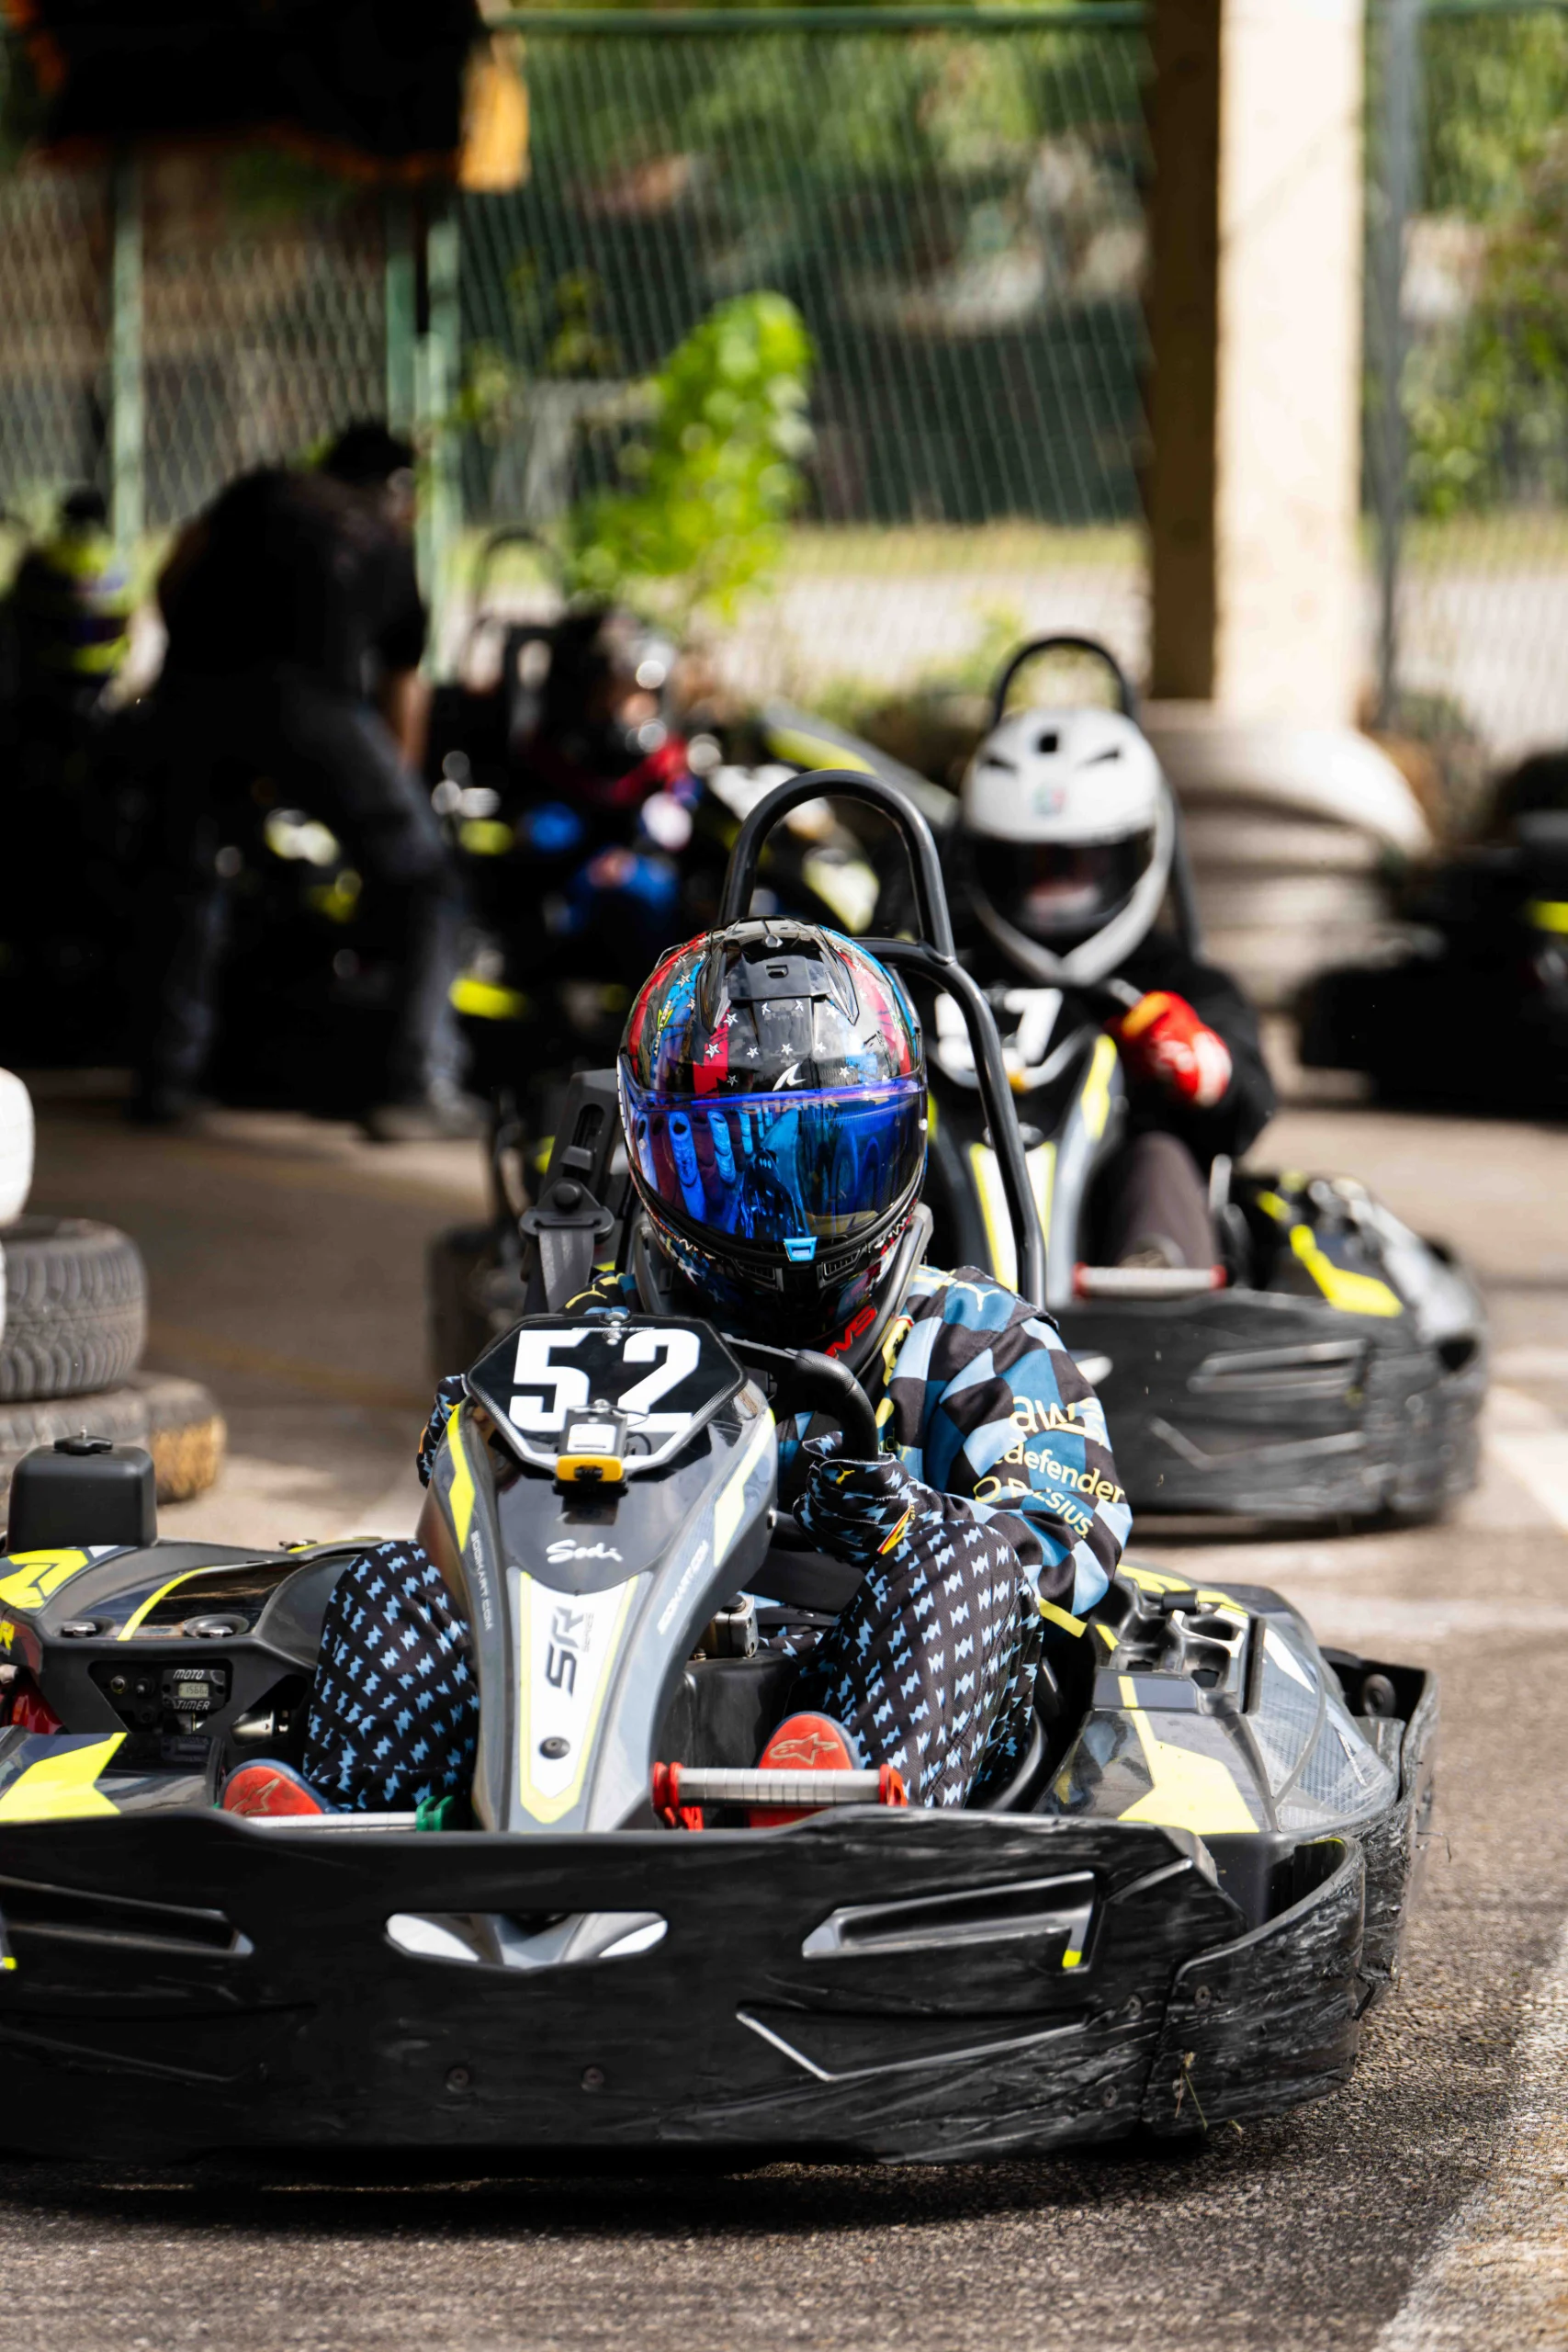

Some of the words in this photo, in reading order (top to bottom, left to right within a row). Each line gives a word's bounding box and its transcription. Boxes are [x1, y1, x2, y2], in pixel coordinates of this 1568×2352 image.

[742, 1095, 840, 1114] SHARK
[825, 1306, 877, 1360] VS
[509, 1329, 701, 1432] 52
[994, 1440, 1126, 1504] defender
[547, 1539, 623, 1564] Sodi
[546, 1605, 584, 1699] SR
[173, 1668, 205, 1680] MOTO
[176, 1700, 210, 1711] TIMER
